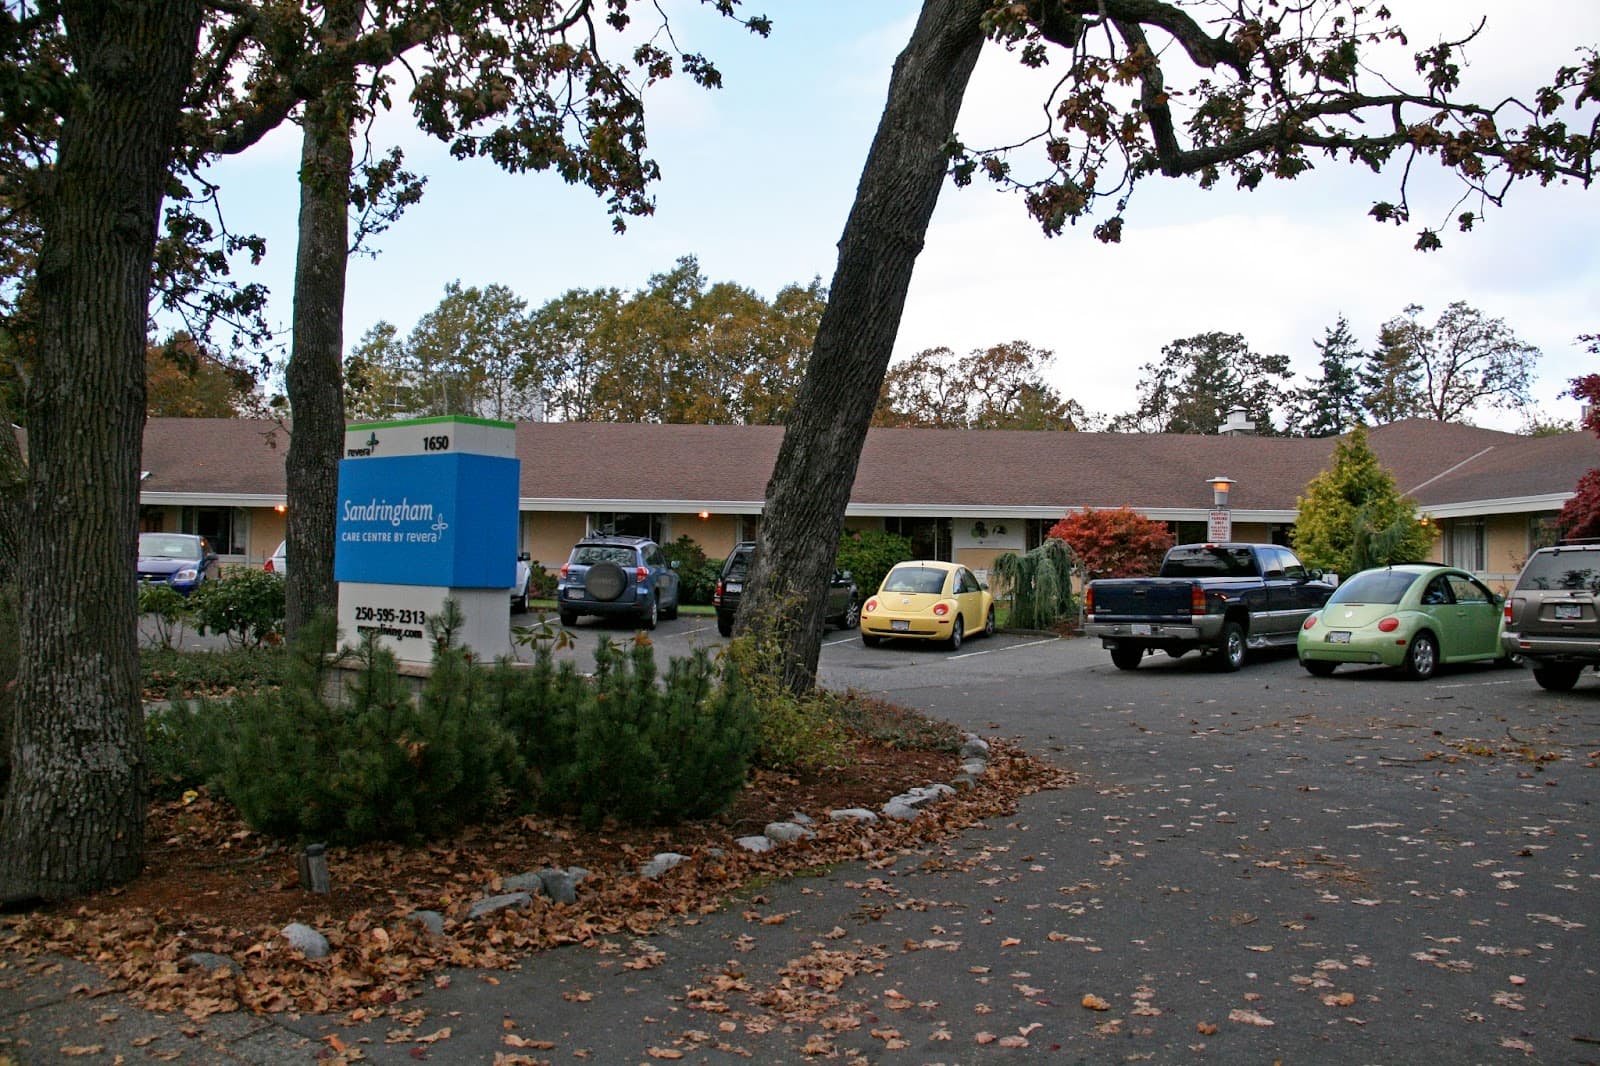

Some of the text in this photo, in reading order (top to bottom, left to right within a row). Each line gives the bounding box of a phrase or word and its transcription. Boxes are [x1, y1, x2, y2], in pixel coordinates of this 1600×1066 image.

[423, 435, 449, 451] 1650
[347, 448, 371, 457] revera
[342, 497, 433, 526] Sandringham
[342, 532, 437, 543] CARE CENTRE BY revera
[355, 606, 425, 625] 250-595-2313
[357, 623, 422, 641] rliving.com
